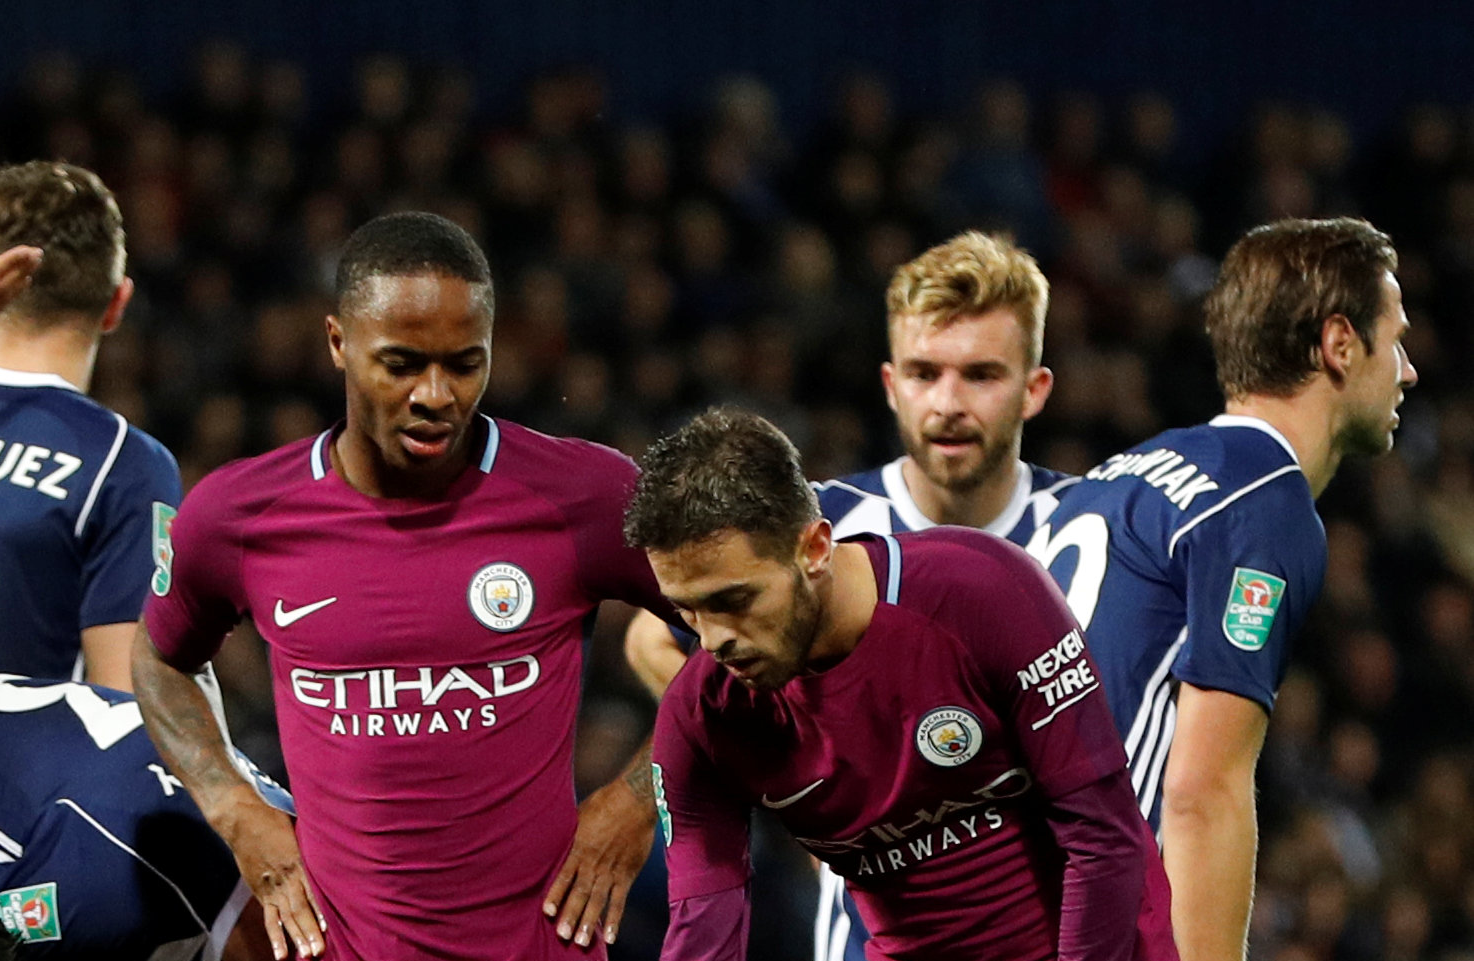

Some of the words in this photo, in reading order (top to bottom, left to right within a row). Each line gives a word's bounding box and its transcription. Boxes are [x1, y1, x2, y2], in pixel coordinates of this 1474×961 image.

[474, 566, 529, 590] MANCHESTER
[494, 618, 515, 628] CITY
[1016, 628, 1086, 690] NEXEN
[290, 654, 541, 710] ETIHAD
[1037, 658, 1096, 707] TIRE
[330, 703, 497, 737] AIRWAYS
[919, 712, 969, 741] MANCHESTER
[952, 752, 972, 765] CITY
[857, 806, 1004, 876] AIRWAYS
